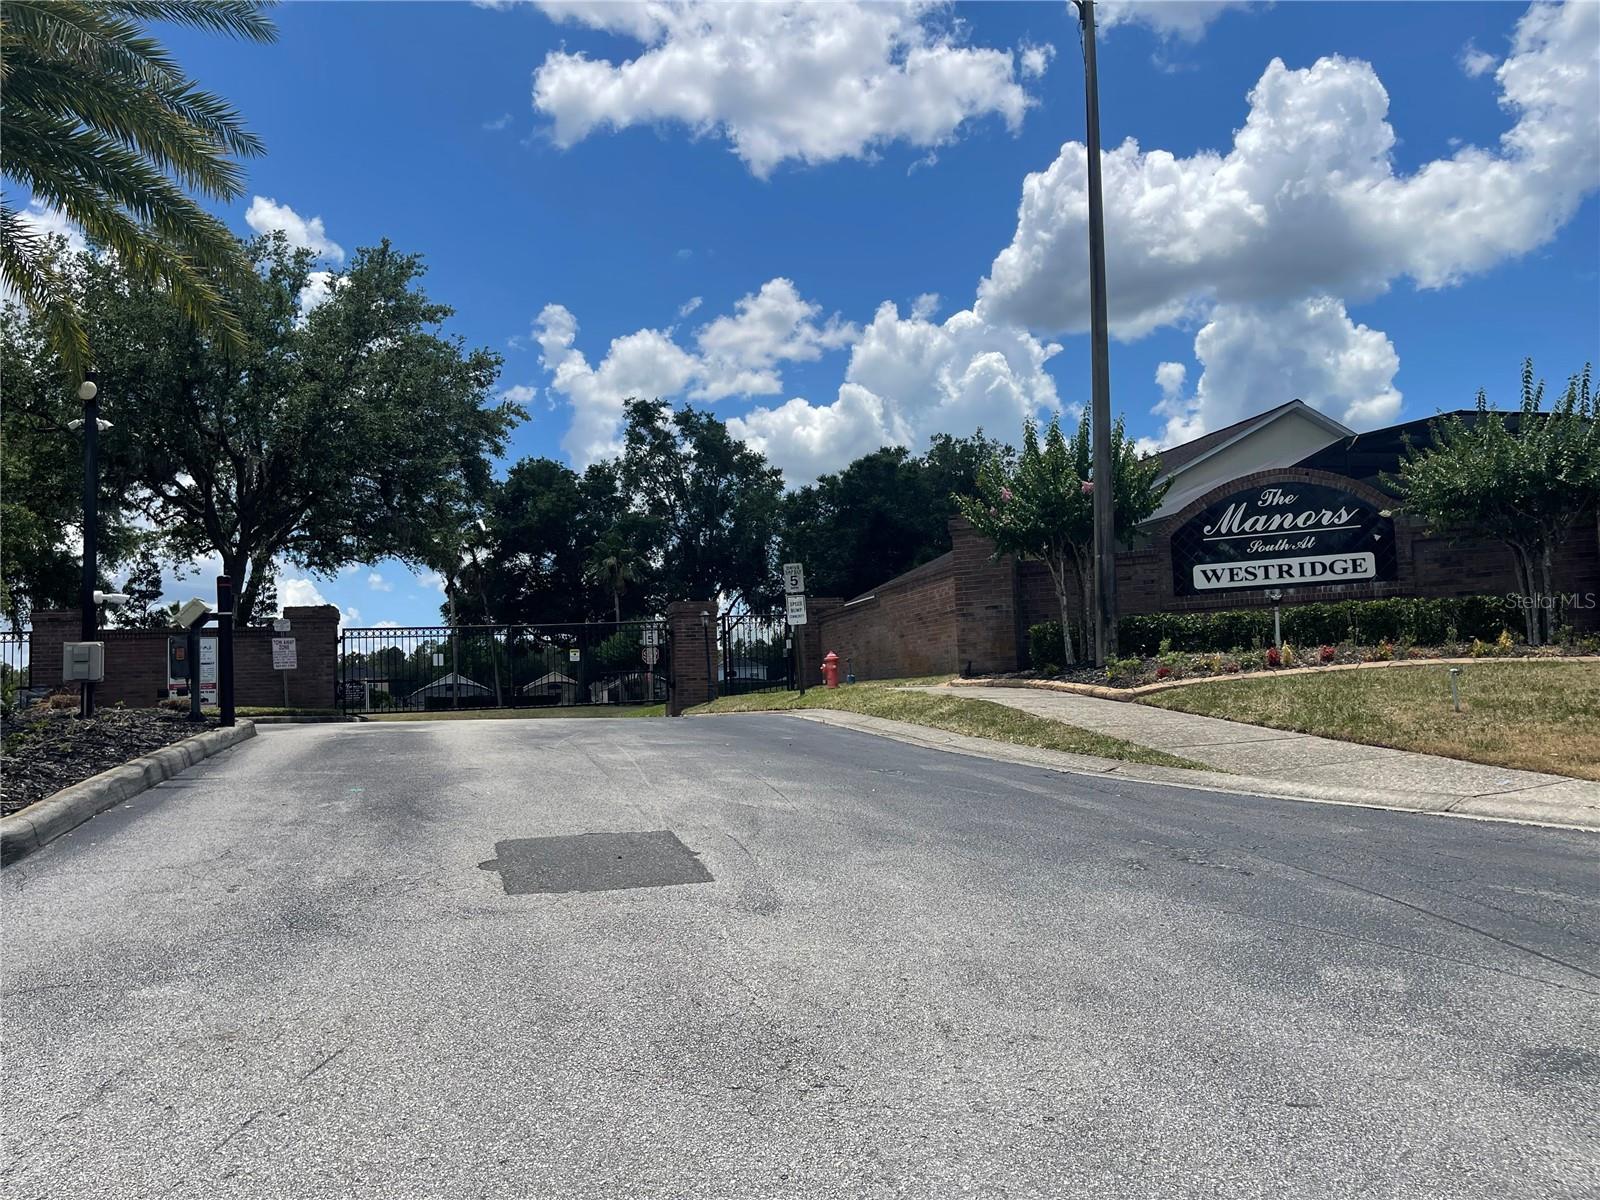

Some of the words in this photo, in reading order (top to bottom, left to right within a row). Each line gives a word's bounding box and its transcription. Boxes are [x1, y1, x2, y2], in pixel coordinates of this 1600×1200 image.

[1257, 488, 1300, 507] The
[1203, 501, 1360, 536] Manors
[1246, 538, 1293, 554] South
[1291, 536, 1316, 551] At
[1200, 557, 1368, 584] WESTRIDGE
[790, 575, 798, 586] 5
